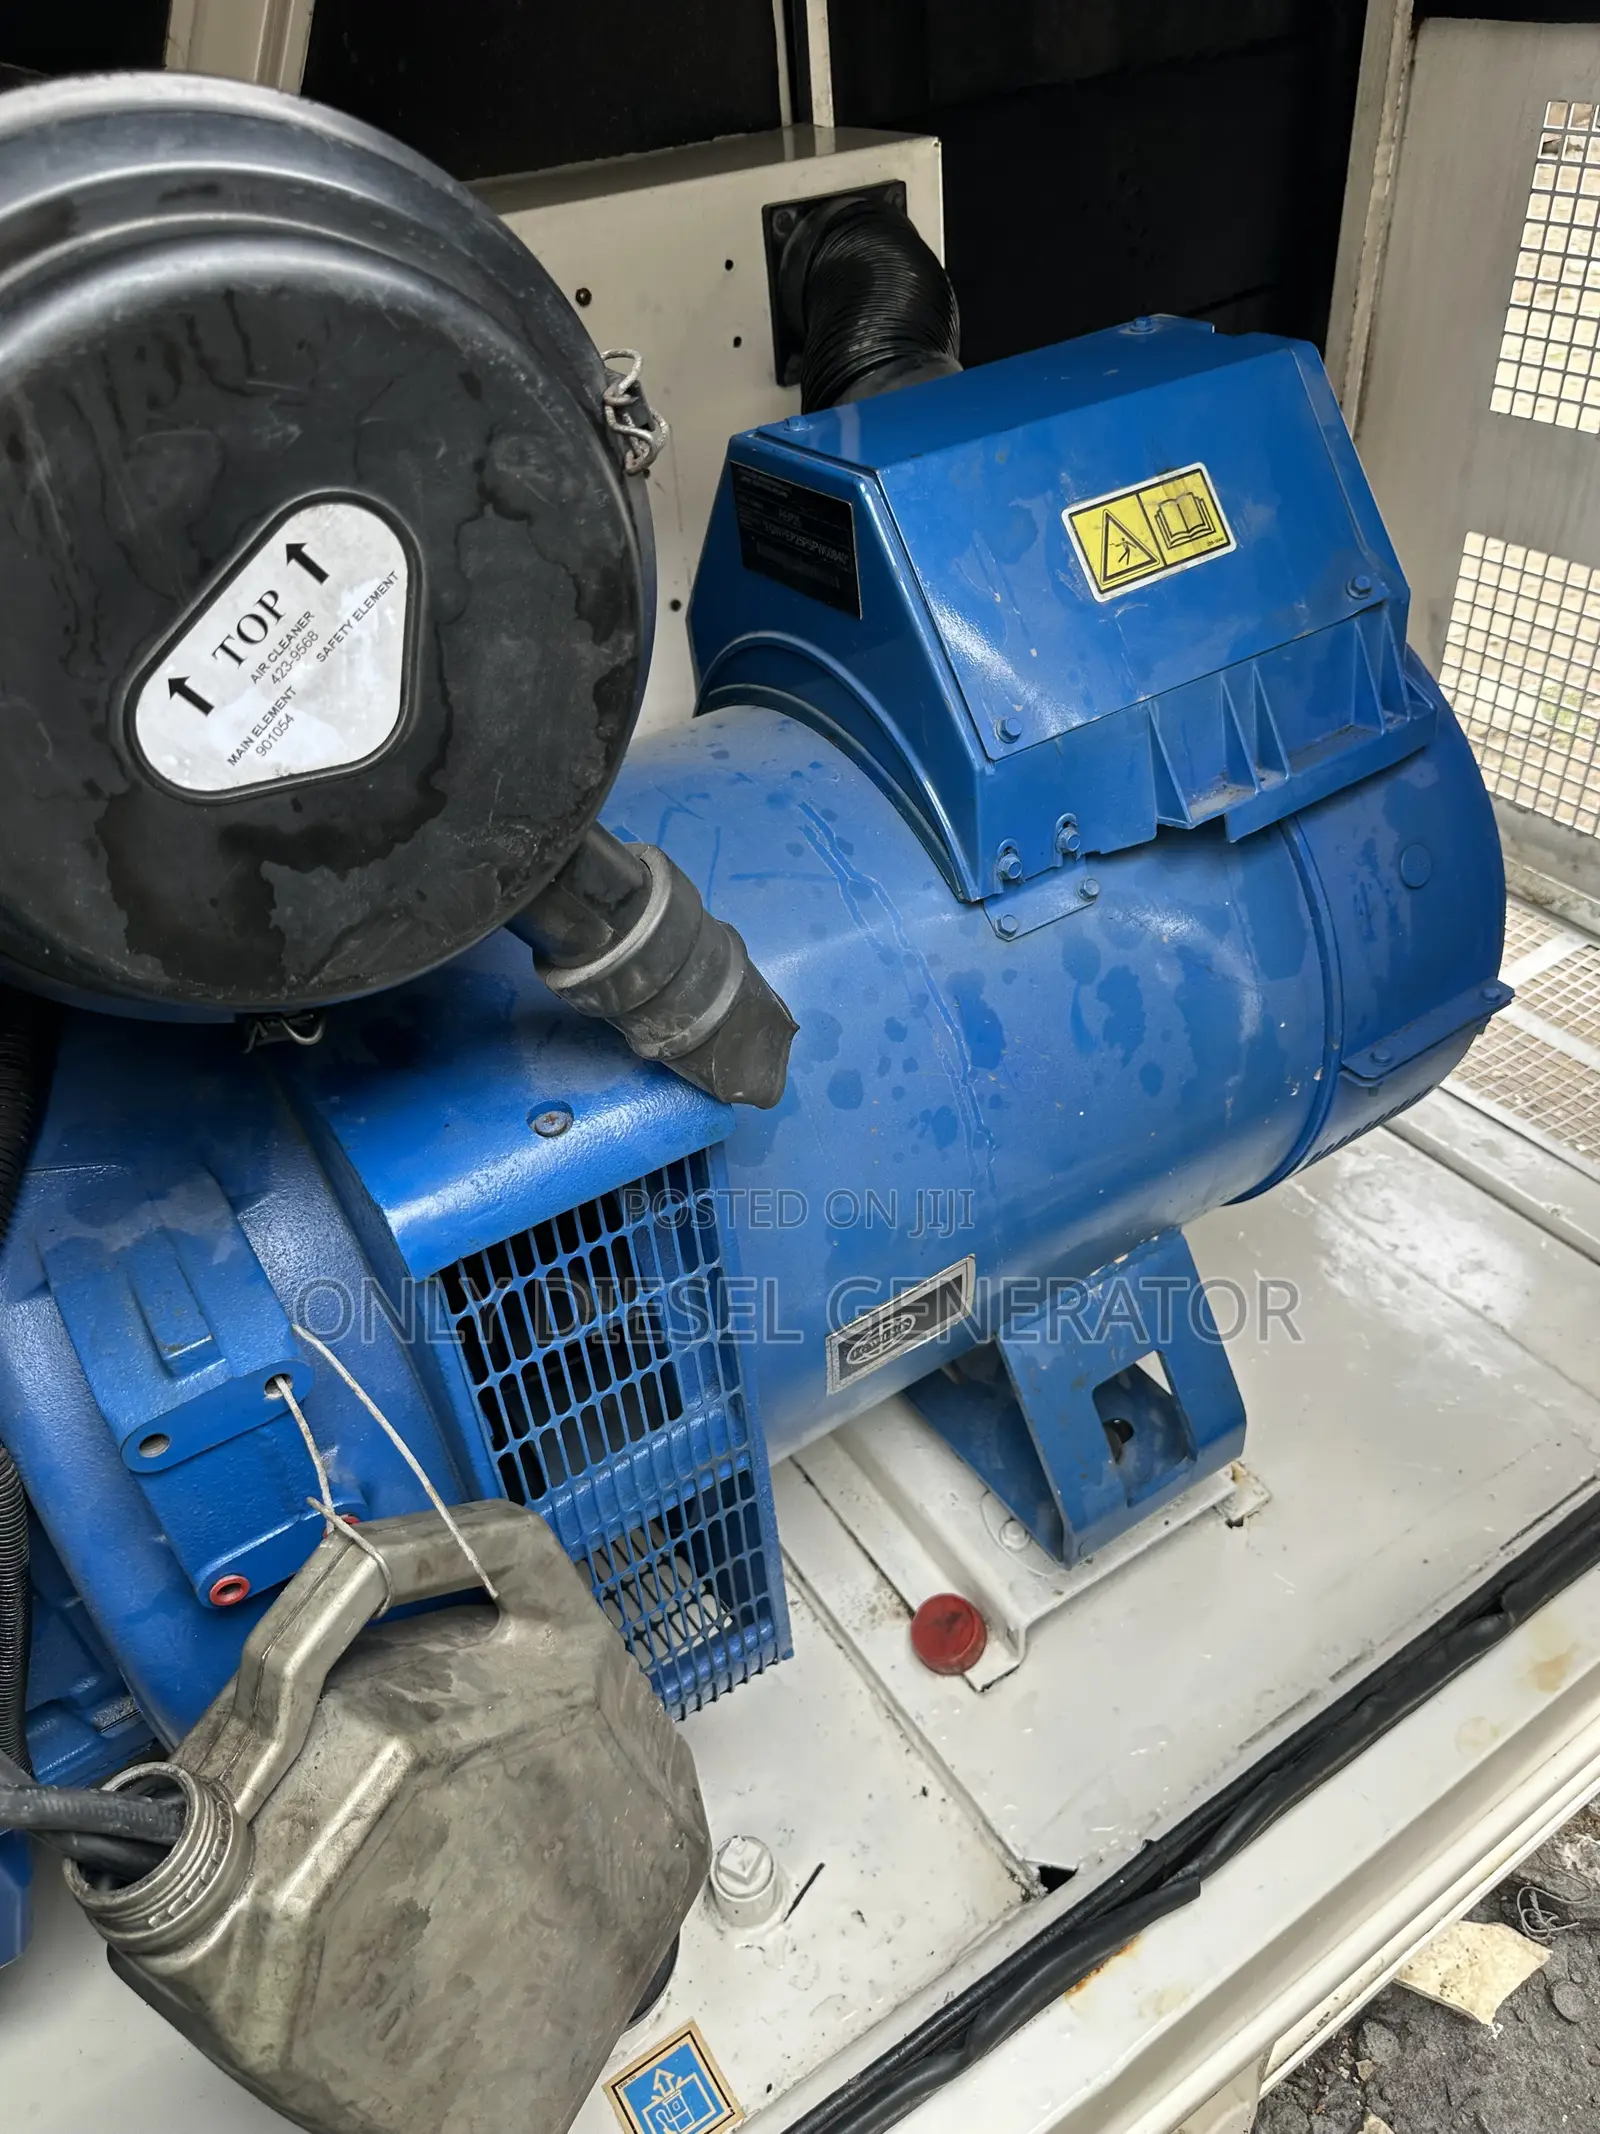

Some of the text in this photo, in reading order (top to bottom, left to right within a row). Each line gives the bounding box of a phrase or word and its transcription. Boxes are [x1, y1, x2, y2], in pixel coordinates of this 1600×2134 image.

[211, 589, 286, 667] TOP
[250, 610, 316, 685] AIR CLEANER
[316, 570, 400, 663] SAFETY ELEMENT
[271, 630, 319, 685] 423-9568
[227, 686, 297, 767] MAIN ELEMENT
[255, 713, 295, 758] 901054
